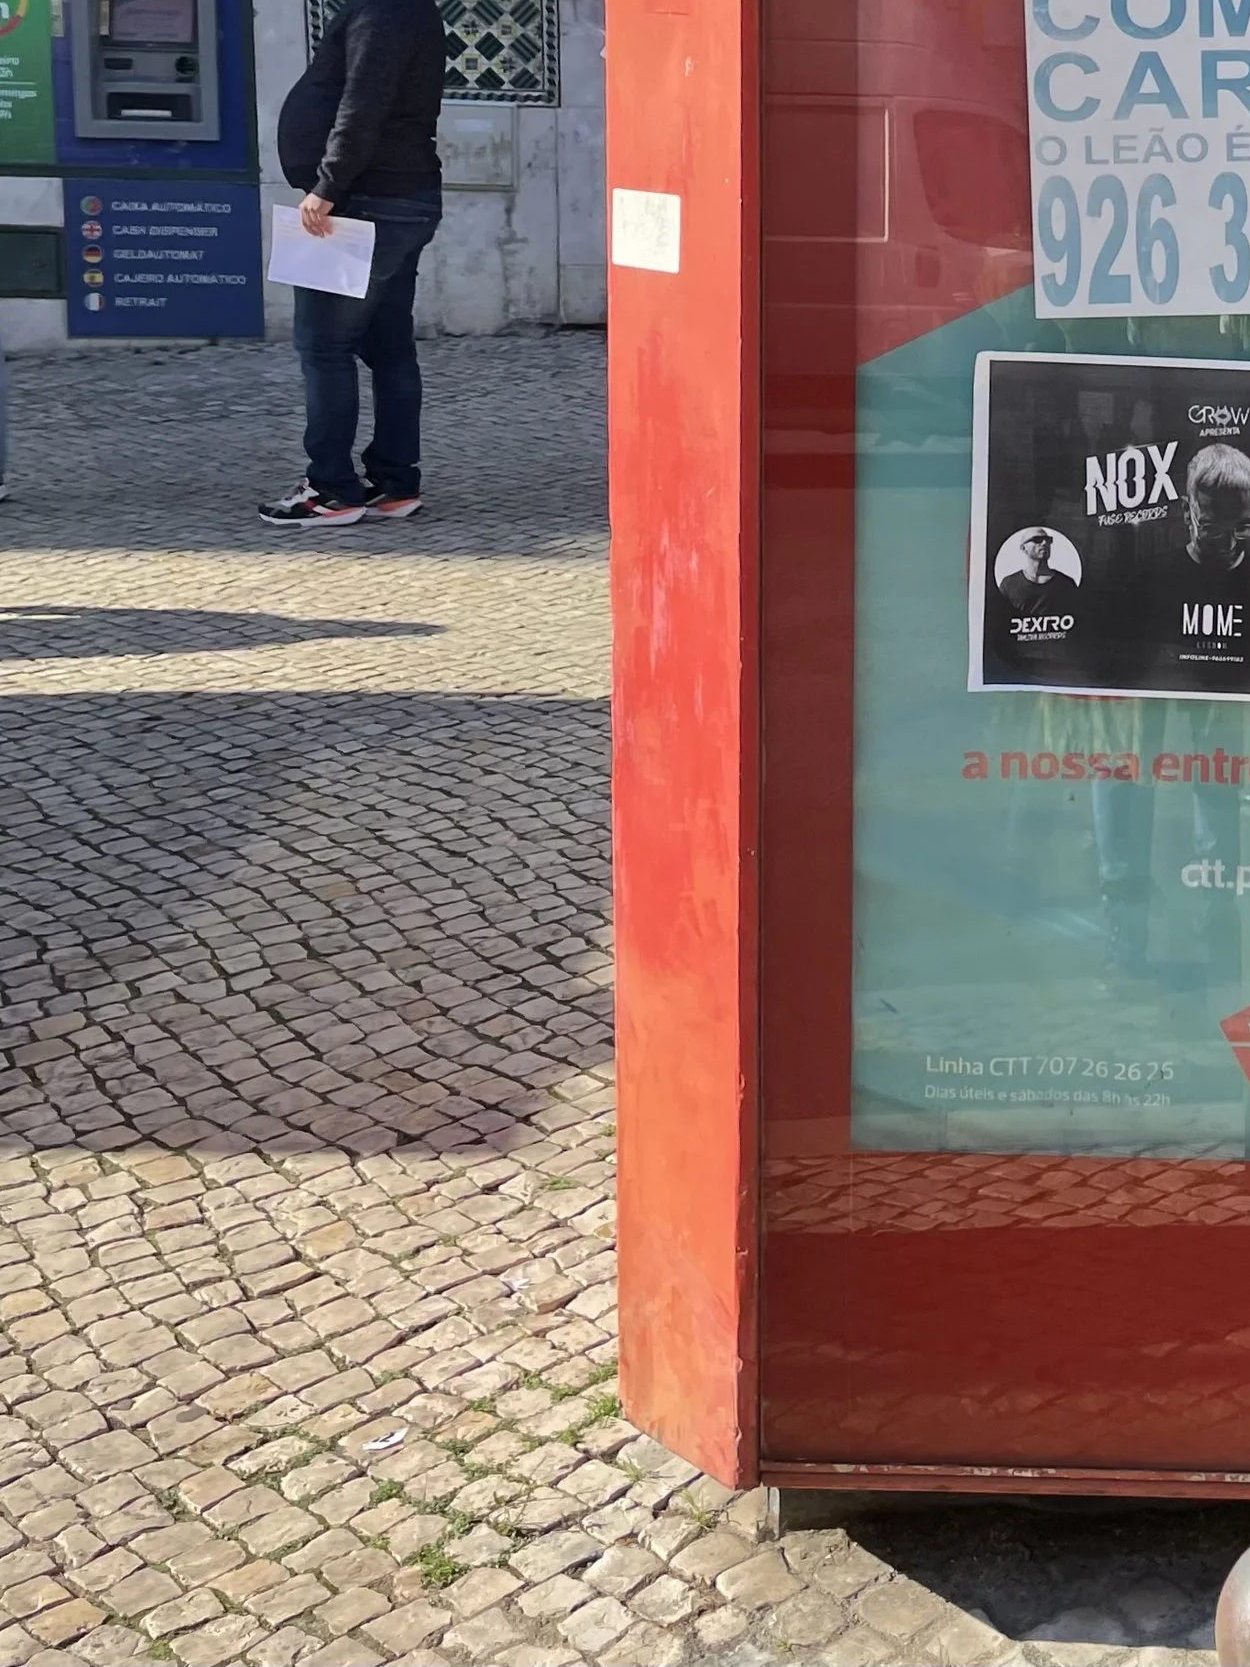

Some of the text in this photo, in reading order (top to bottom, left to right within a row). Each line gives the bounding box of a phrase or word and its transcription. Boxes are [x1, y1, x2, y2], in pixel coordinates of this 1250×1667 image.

[1036, 134, 1068, 167] O
[1084, 127, 1209, 165] LEÃO
[1037, 172, 1180, 308] 926
[1084, 441, 1180, 517] NOX
[1182, 602, 1244, 637] MOME
[962, 749, 989, 780] a
[1000, 749, 1140, 781] nossa
[925, 1054, 984, 1076] Linha
[989, 1056, 1033, 1077] CTT
[1036, 1055, 1078, 1076] 707
[1081, 1058, 1109, 1078] 26
[1113, 1061, 1142, 1082] 26
[924, 1083, 957, 1099] Dias
[959, 1083, 995, 1101] úteis
[1073, 1087, 1099, 1104] das
